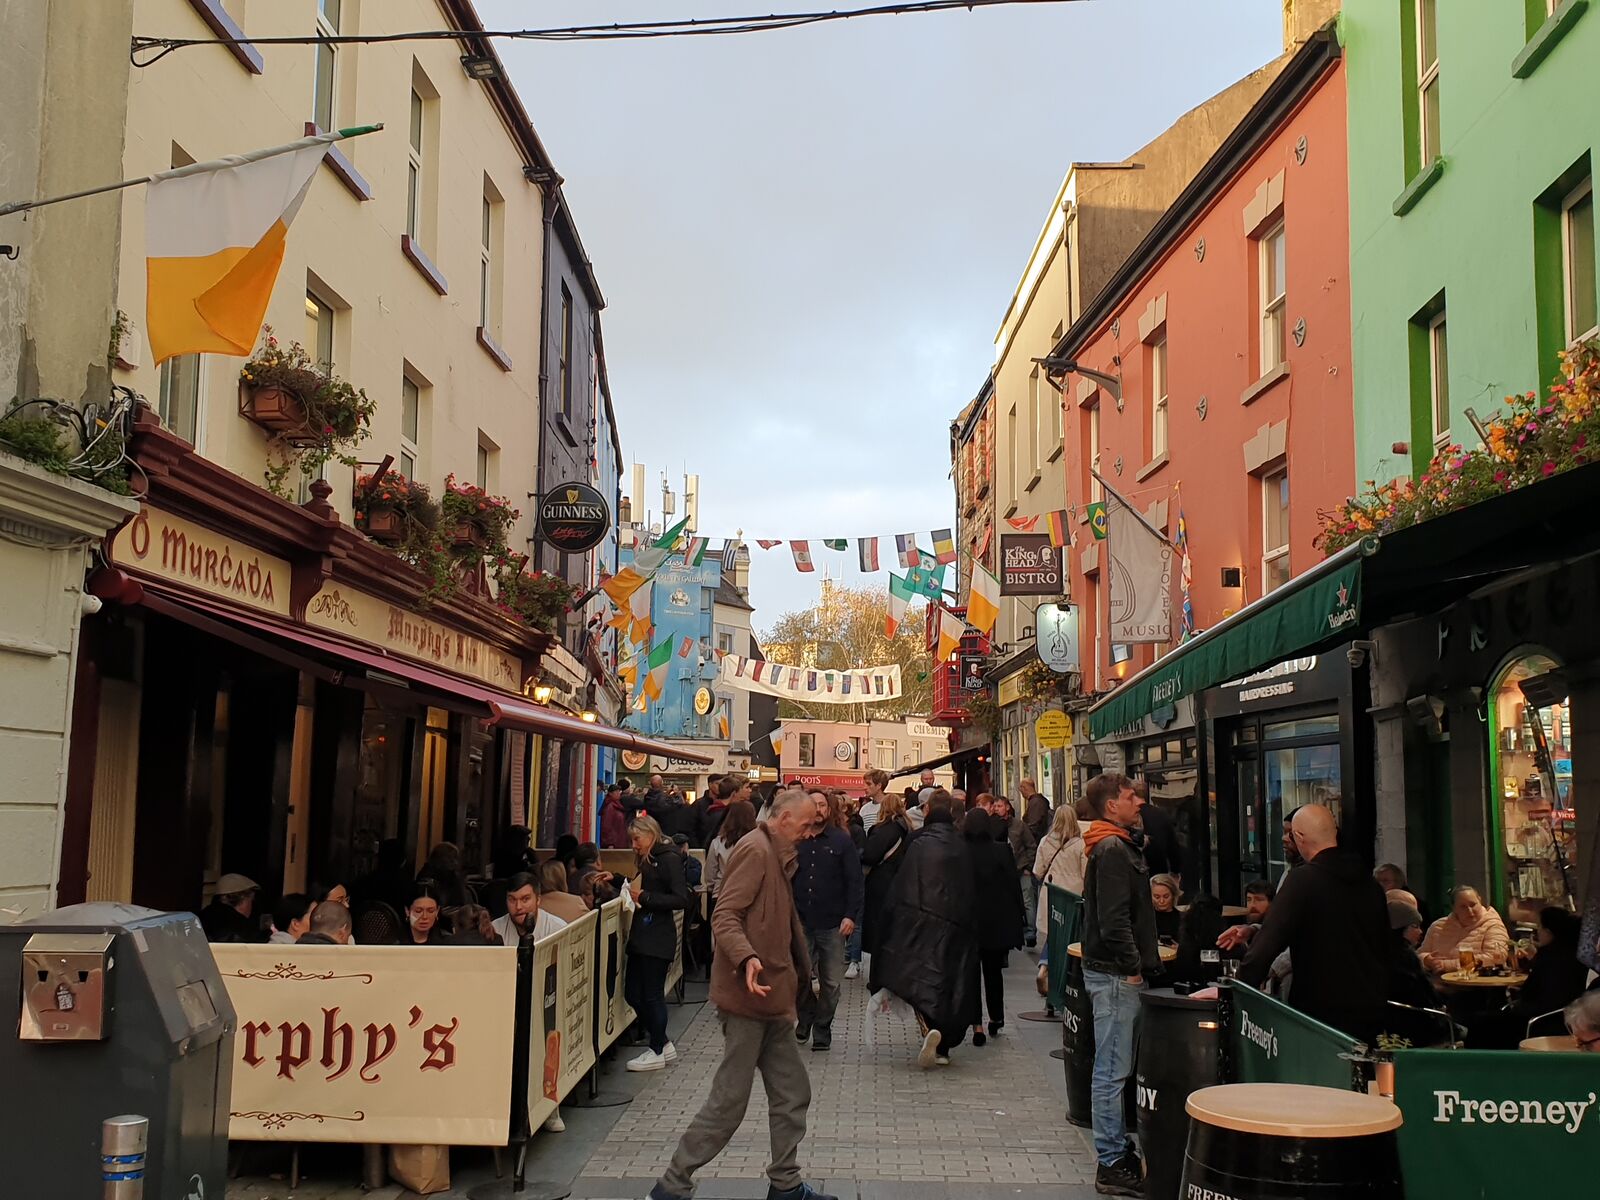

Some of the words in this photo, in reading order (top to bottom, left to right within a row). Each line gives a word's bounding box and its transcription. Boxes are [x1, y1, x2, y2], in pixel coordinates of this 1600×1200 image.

[542, 504, 603, 520] GUINNESS
[1005, 560, 1035, 568] HEAD
[1005, 572, 1057, 585] BISTRO
[1122, 624, 1172, 636] MUSIC
[795, 775, 822, 785] ROOTS
[1240, 1009, 1278, 1059] Freeney's
[1433, 1090, 1600, 1134] Freeney'
